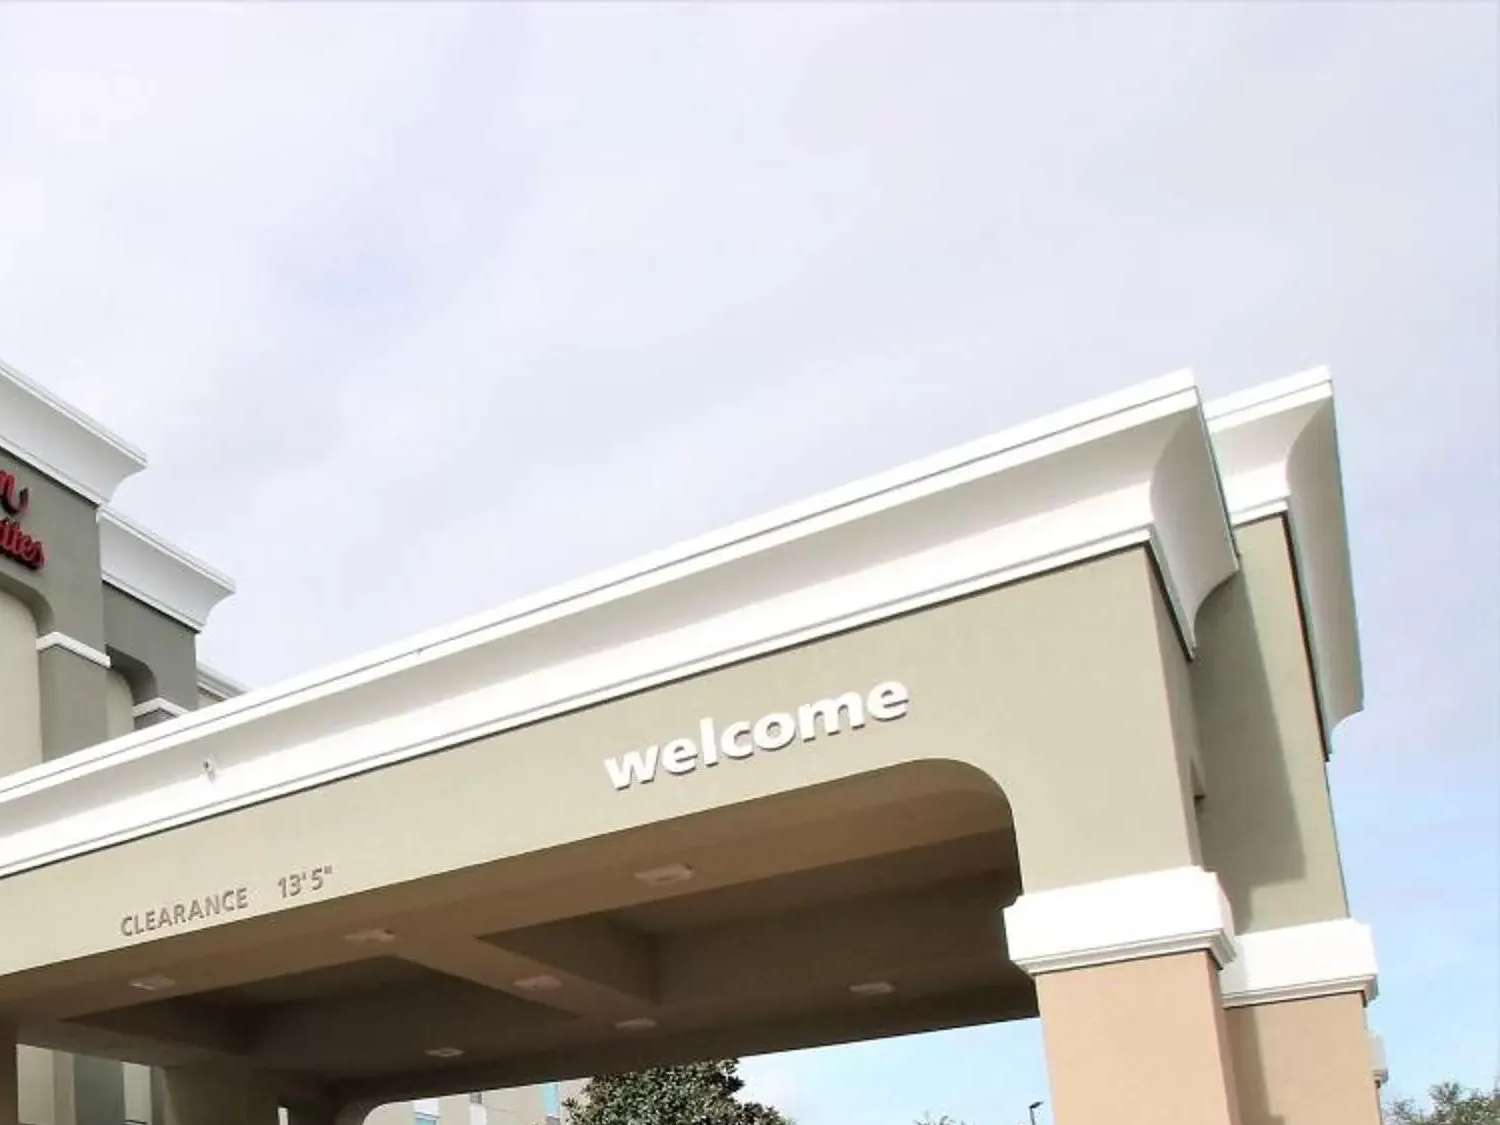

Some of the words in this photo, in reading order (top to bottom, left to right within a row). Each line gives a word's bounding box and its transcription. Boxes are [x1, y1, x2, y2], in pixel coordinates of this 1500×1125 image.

[603, 680, 909, 791] welcome
[120, 887, 249, 936] CLEARANCE
[277, 864, 333, 899] 13'5"
